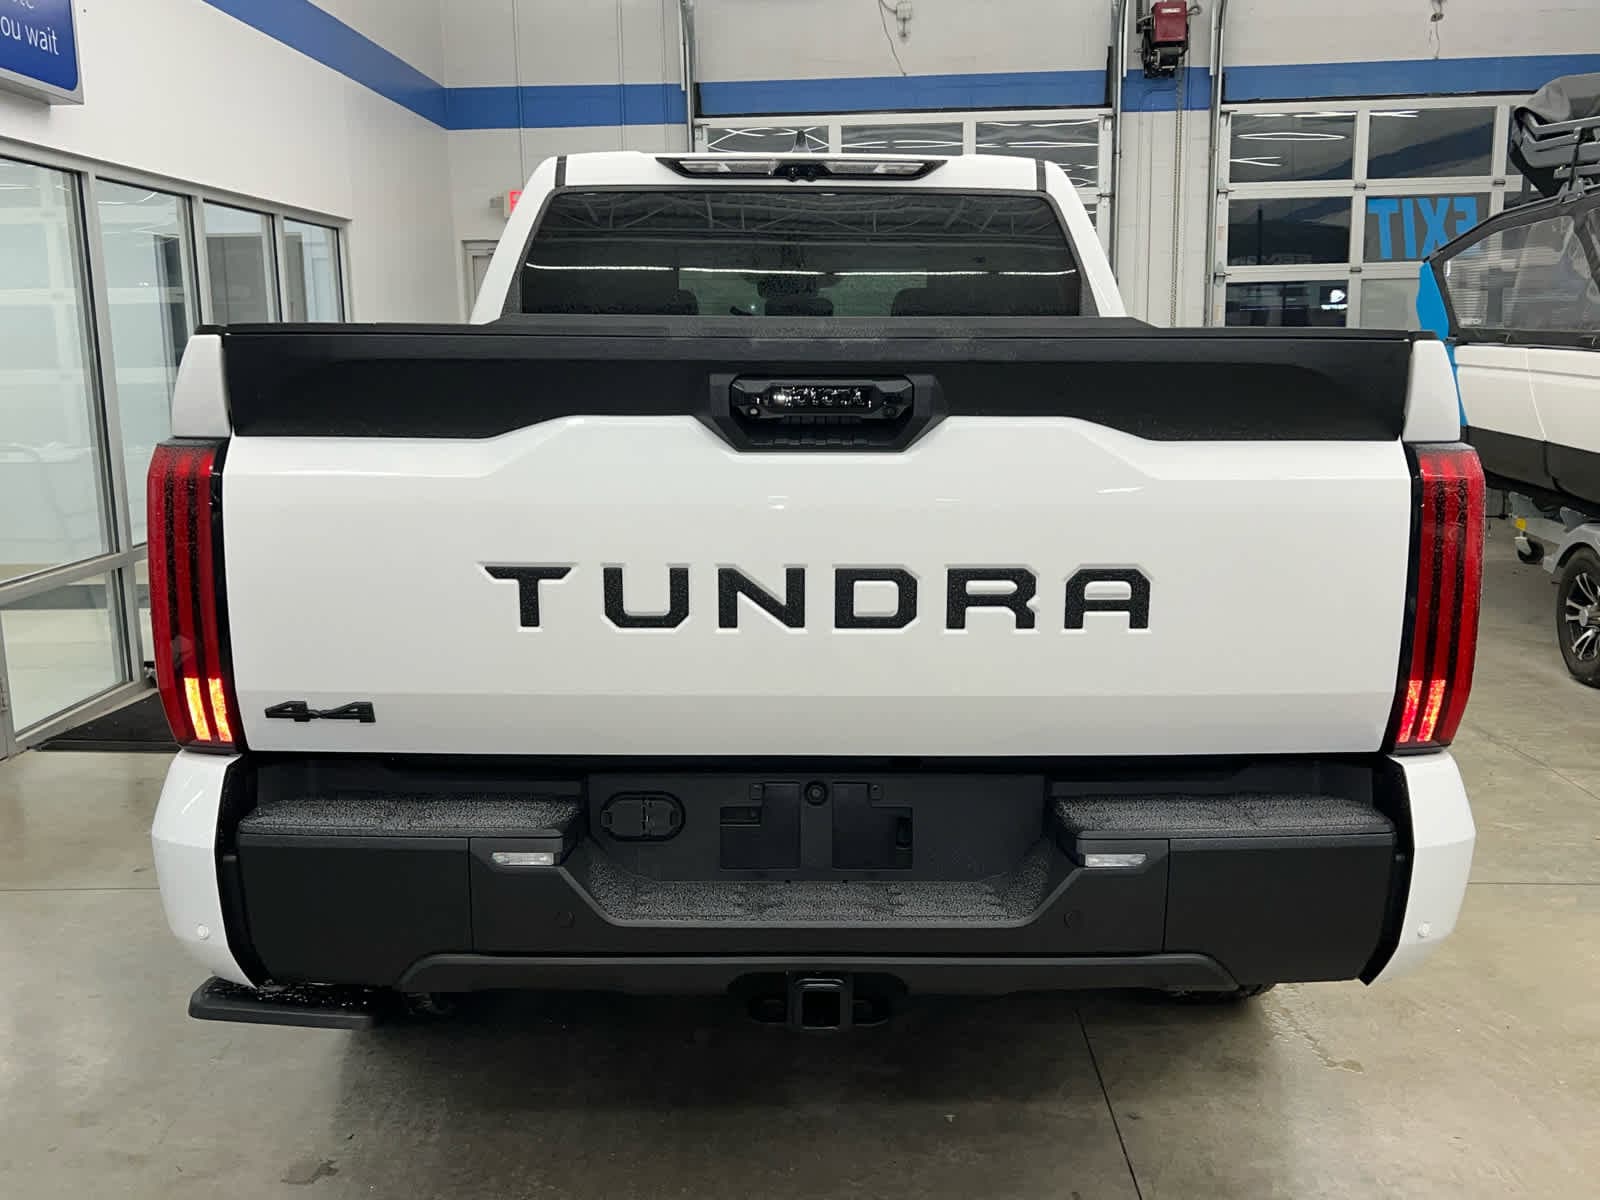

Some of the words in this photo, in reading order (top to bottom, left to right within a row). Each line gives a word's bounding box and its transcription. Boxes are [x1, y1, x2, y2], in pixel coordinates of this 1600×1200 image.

[0, 15, 21, 41] ou
[24, 25, 60, 56] wait
[482, 565, 1151, 630] TUNDRA
